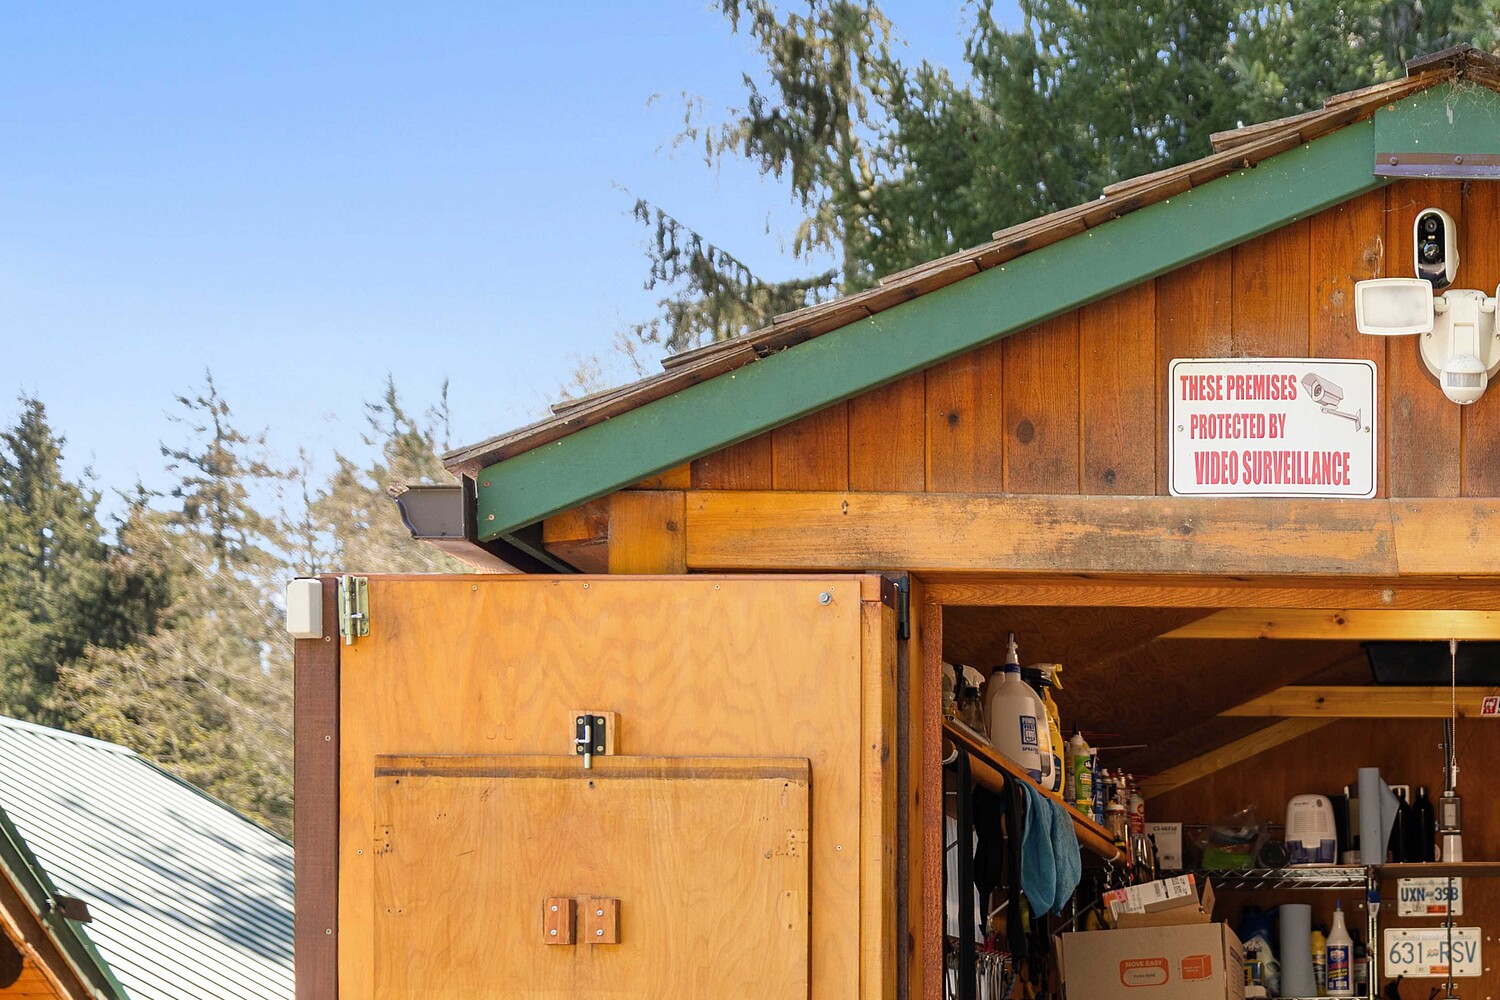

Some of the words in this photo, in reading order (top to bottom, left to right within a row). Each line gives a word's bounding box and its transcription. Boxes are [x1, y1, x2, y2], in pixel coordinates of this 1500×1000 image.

[1180, 374, 1223, 401] THESE
[1226, 374, 1297, 401] PREMISES
[1190, 413, 1265, 440] PROTECTED
[1269, 413, 1286, 439] BY
[1194, 450, 1239, 485] VIDEO
[1242, 450, 1350, 485] SURVEILLANCE
[1401, 887, 1426, 901] UXN
[1389, 941, 1422, 964] 631
[1440, 941, 1477, 964] RSV
